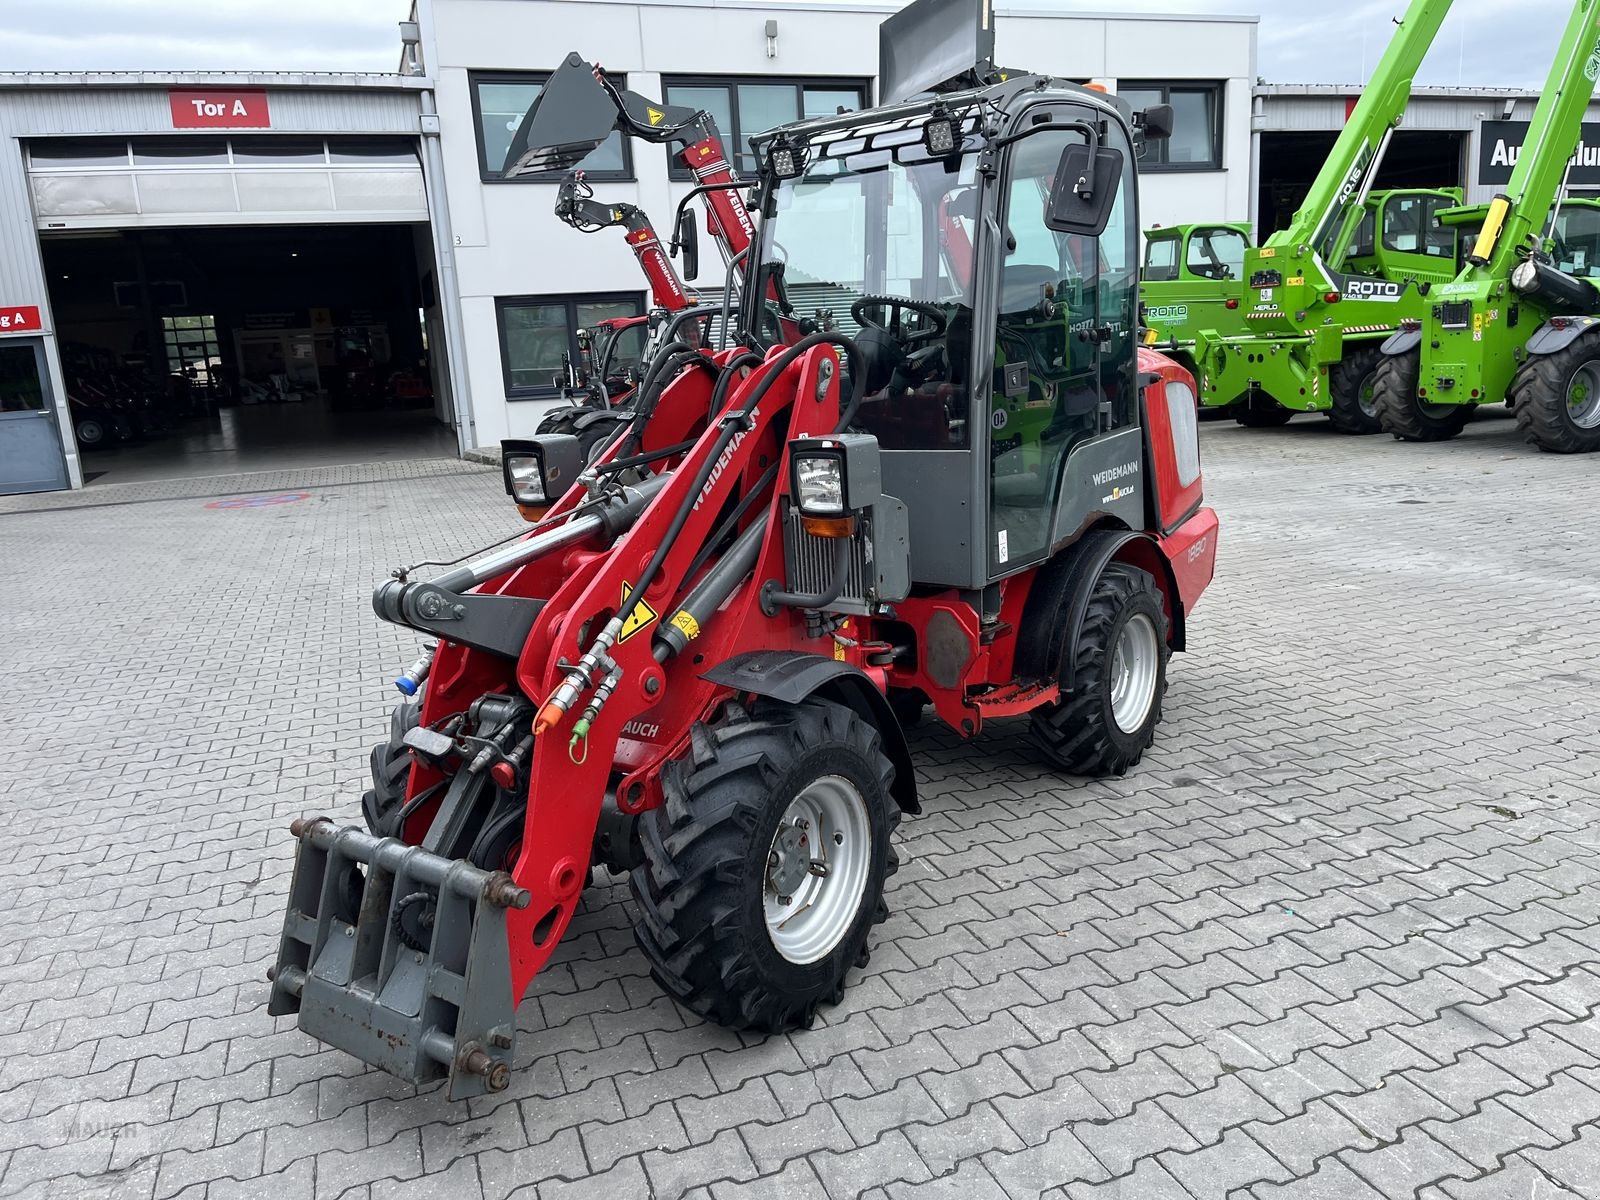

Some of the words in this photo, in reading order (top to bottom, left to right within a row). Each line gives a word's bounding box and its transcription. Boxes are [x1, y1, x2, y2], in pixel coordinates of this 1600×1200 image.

[191, 100, 226, 117] Tor
[232, 99, 248, 117] A
[1339, 167, 1362, 205] 40.16
[726, 188, 754, 241] WEIDEM
[455, 235, 462, 245] 3
[654, 251, 681, 297] WEIDEMANN
[1347, 280, 1399, 296] ROTO
[0, 316, 11, 328] g
[14, 312, 26, 324] A
[1148, 305, 1187, 317] ROTO
[1092, 460, 1138, 486] WEIDEMANN
[622, 720, 659, 738] AUCH
